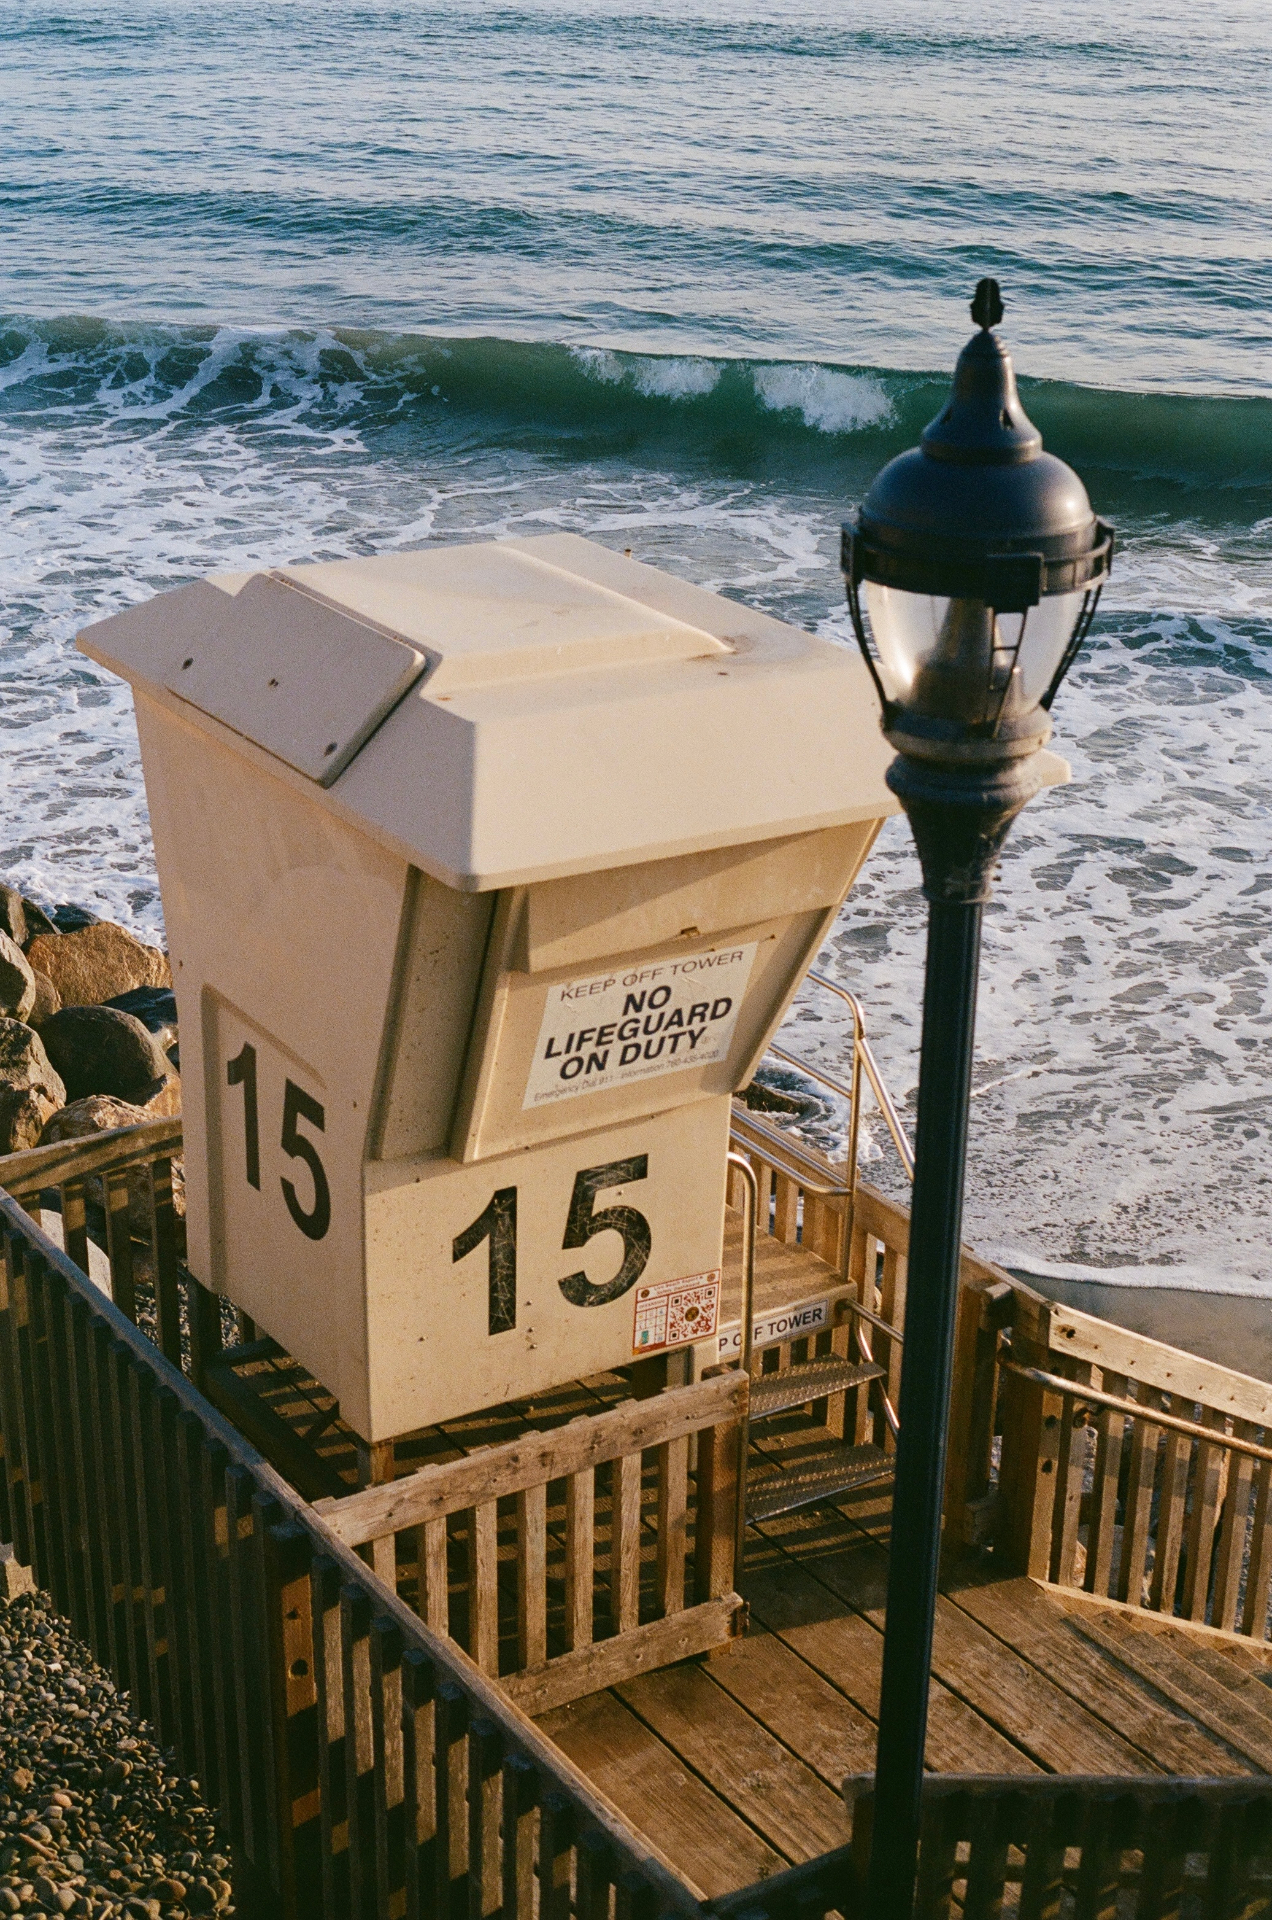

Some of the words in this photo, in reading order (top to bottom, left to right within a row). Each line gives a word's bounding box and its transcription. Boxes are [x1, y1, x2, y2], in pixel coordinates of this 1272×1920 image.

[560, 978, 616, 1001] KEEP
[622, 967, 664, 987] OFF
[671, 951, 744, 975] TOWER
[622, 985, 672, 1017] NO
[544, 997, 733, 1060] LIFEGUARD
[559, 1049, 610, 1080] ON
[618, 1027, 707, 1066] DUTY
[227, 1041, 331, 1241] 15
[453, 1154, 652, 1336] 15
[733, 1326, 763, 1346] OF
[768, 1308, 822, 1335] TOWER
